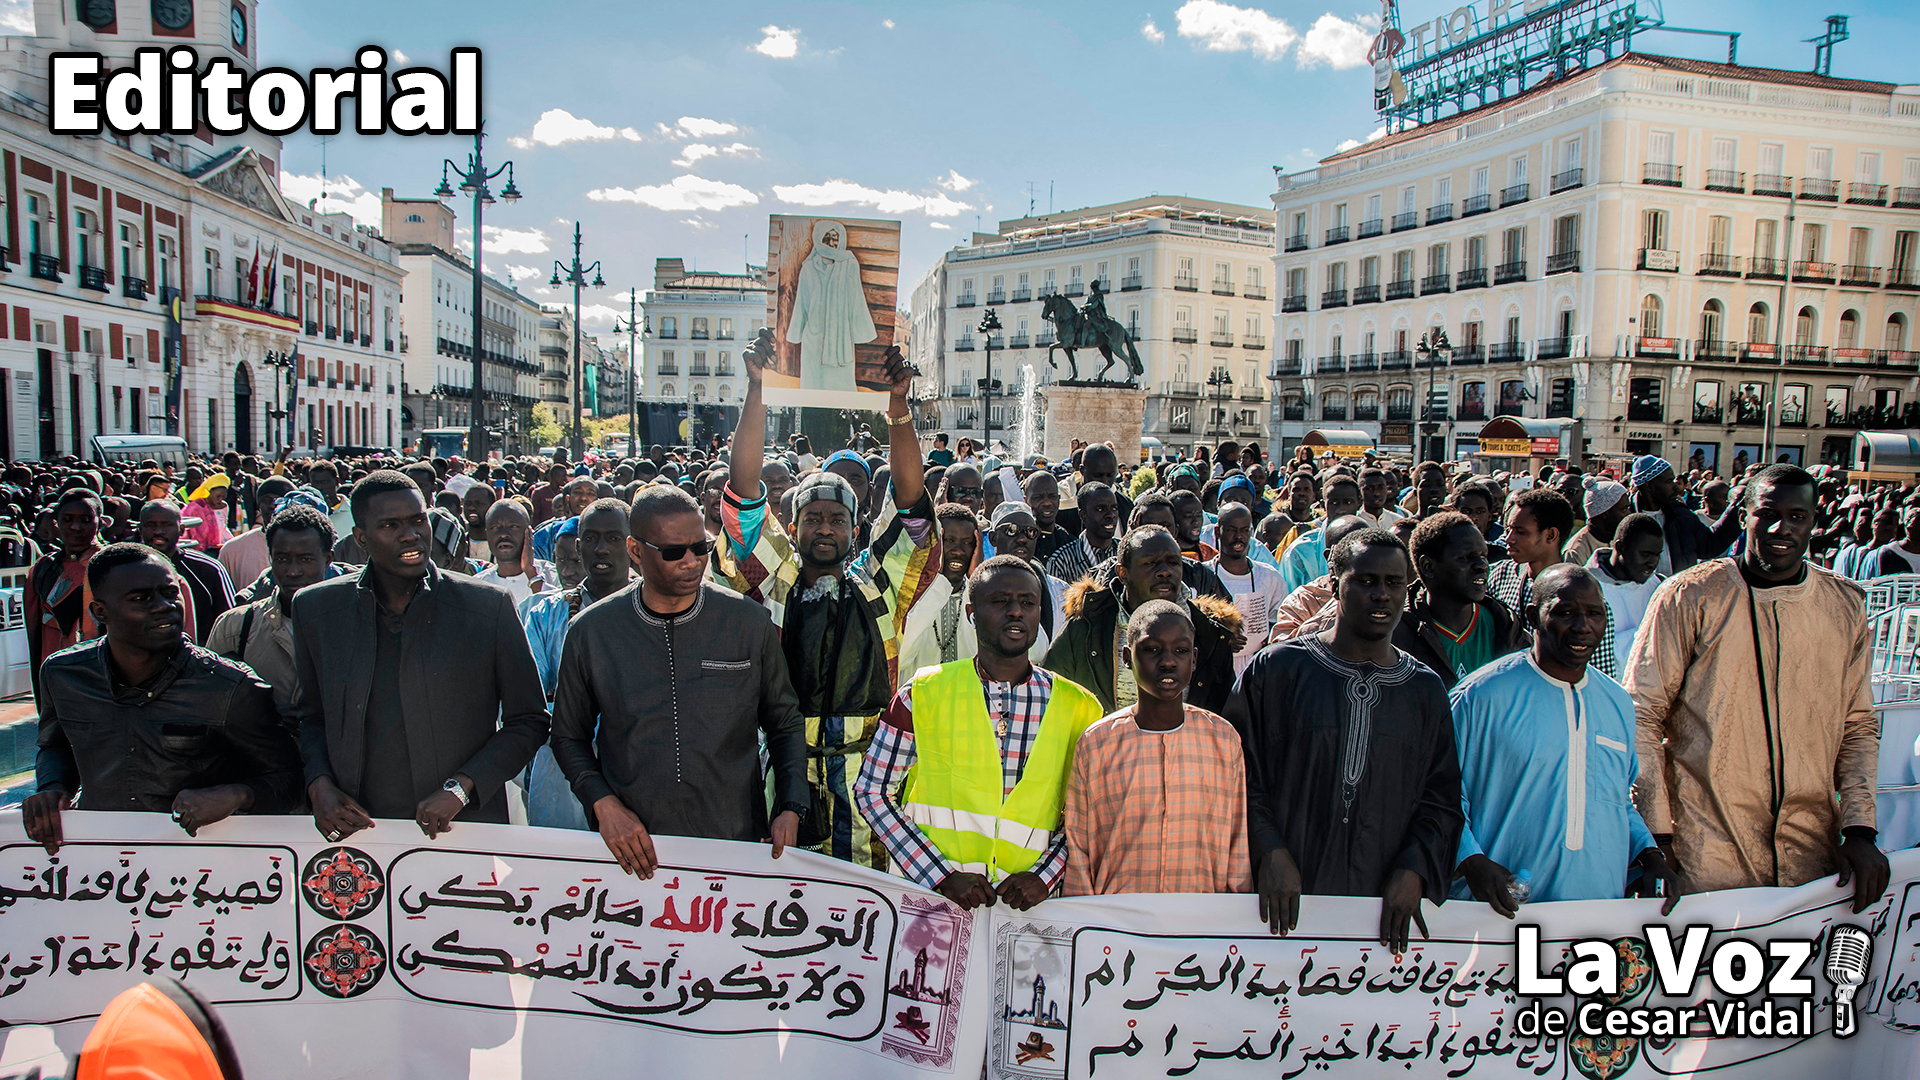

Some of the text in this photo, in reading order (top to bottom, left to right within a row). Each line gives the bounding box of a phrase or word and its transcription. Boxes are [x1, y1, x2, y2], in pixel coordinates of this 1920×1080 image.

[1410, 5, 1473, 59] TIO
[1432, 57, 1448, 71] DE
[1628, 431, 1663, 439] SEPHORA
[1487, 443, 1500, 452] TOURS
[1504, 443, 1522, 452] TICKETS
